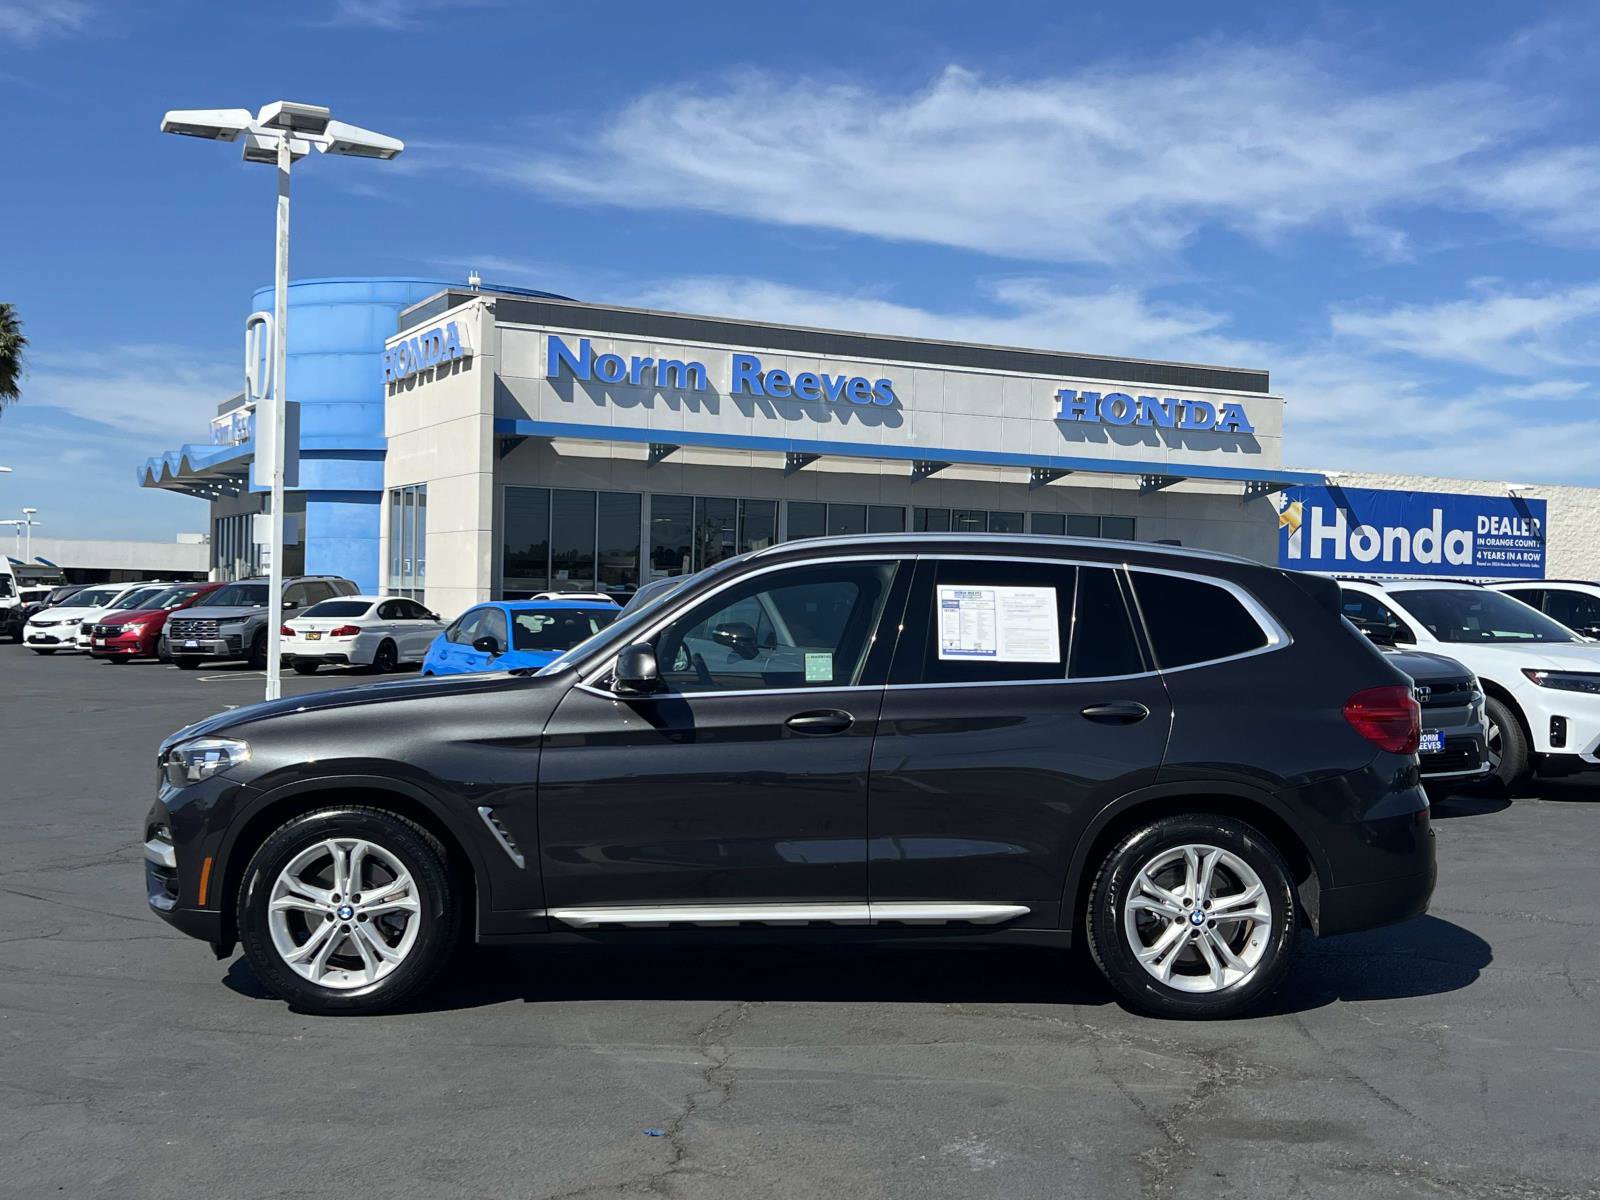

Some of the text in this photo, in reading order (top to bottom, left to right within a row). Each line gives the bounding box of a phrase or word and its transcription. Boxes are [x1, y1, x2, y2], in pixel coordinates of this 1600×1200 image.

[380, 321, 463, 385] HONDA
[547, 335, 894, 406] Norm Reeves
[1056, 389, 1255, 434] HONDA
[1310, 506, 1474, 565] Honda
[1477, 515, 1540, 536] DEALER
[1486, 538, 1514, 546] ORANGE
[1476, 551, 1541, 561] 4 YEARS IN A ROW
[1419, 741, 1440, 750] EEVES
